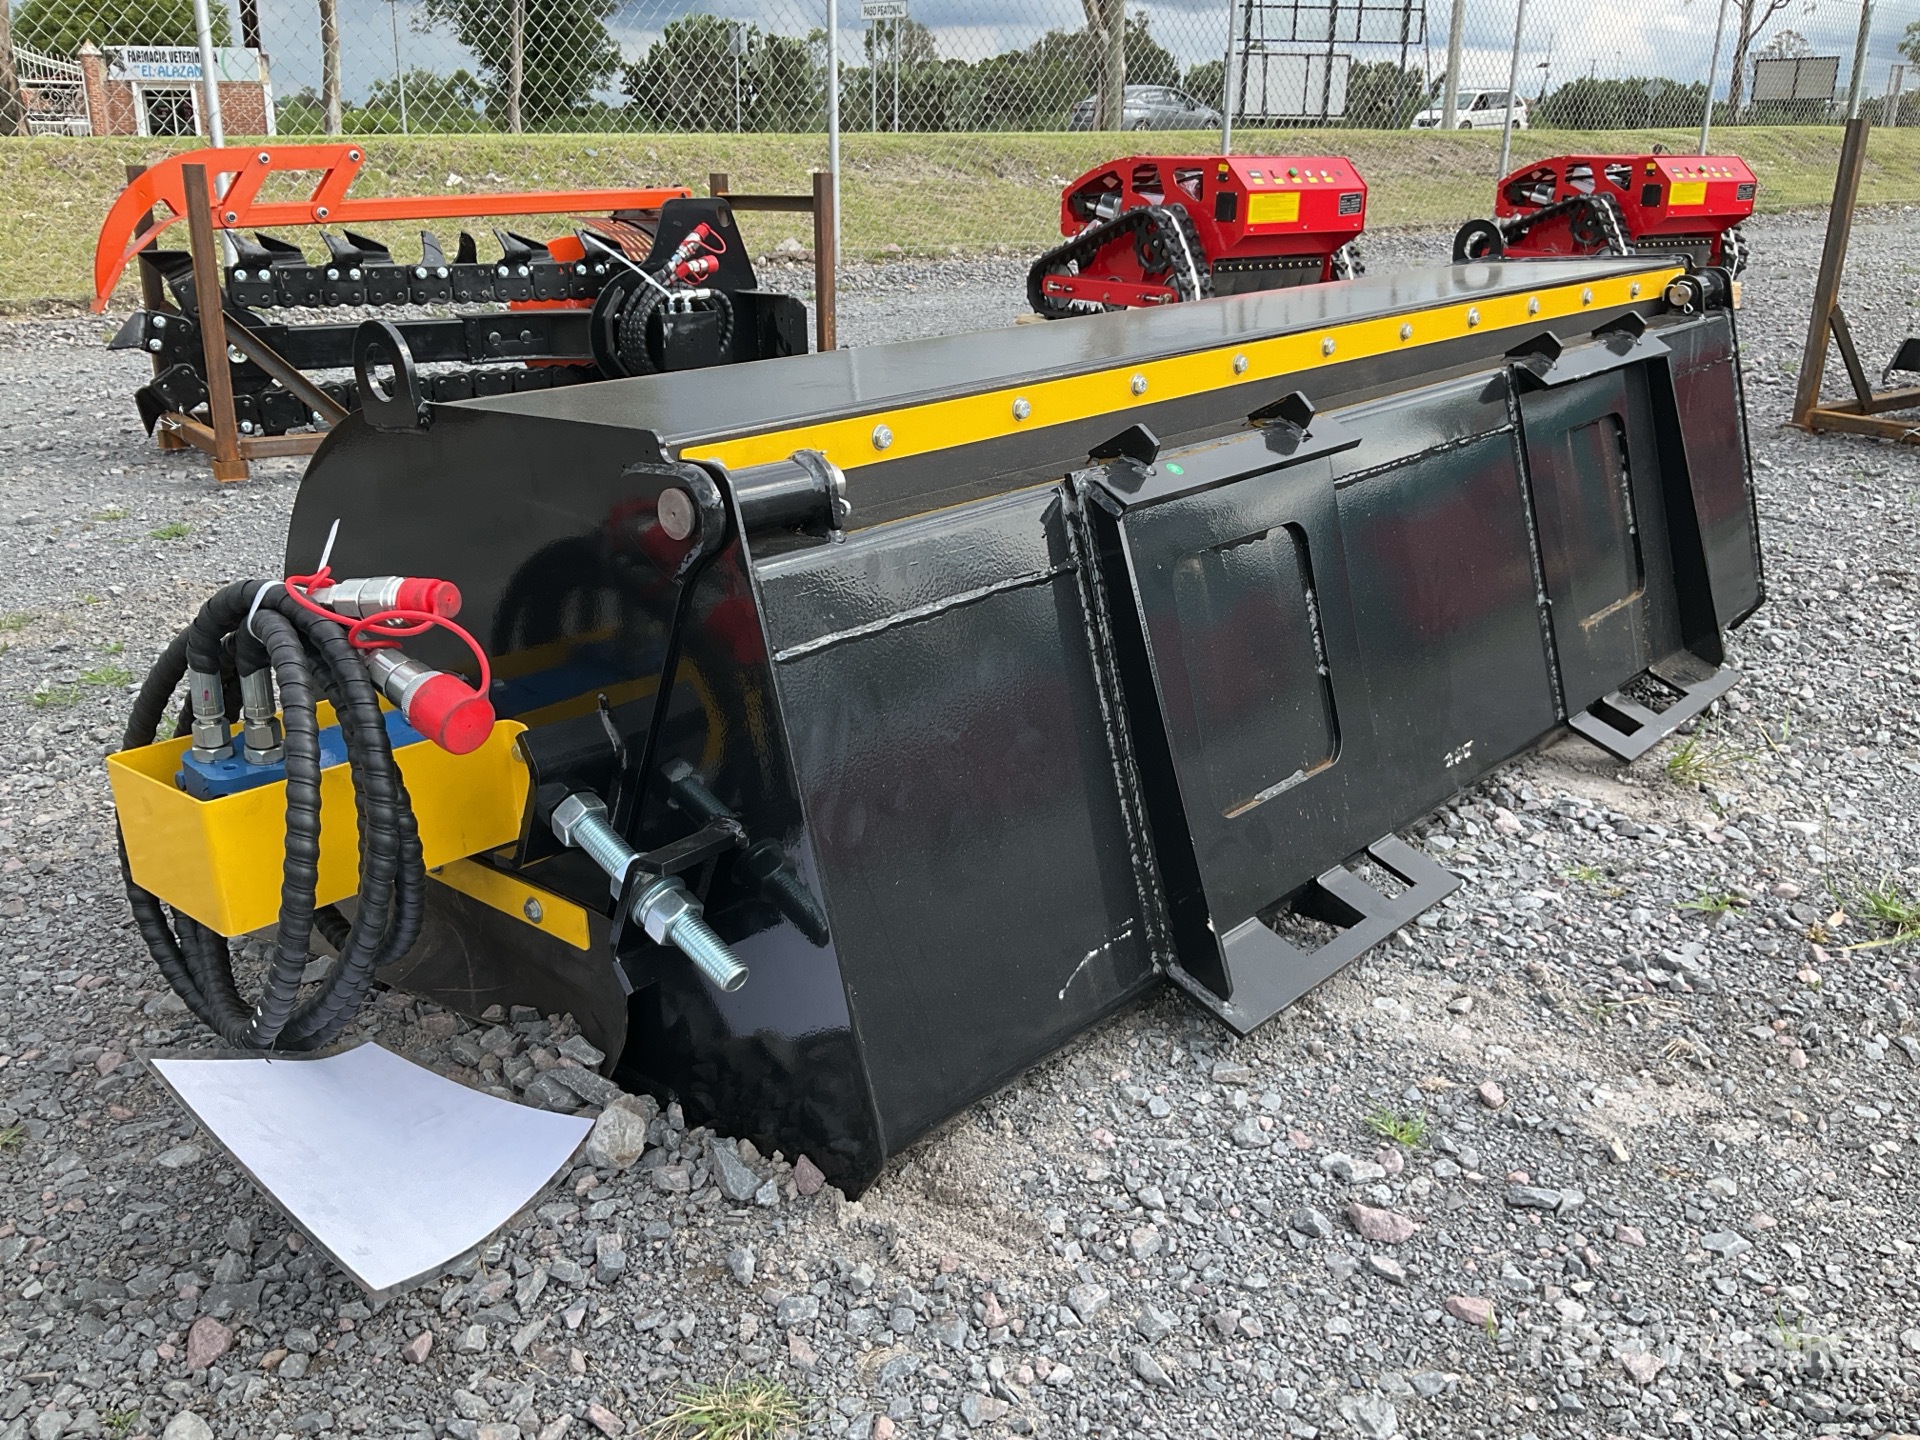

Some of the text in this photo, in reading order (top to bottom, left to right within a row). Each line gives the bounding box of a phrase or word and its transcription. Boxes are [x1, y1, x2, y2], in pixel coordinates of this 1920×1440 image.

[863, 5, 903, 16] PASO PEATONAL
[127, 50, 218, 63] FARMACIA VETERINA
